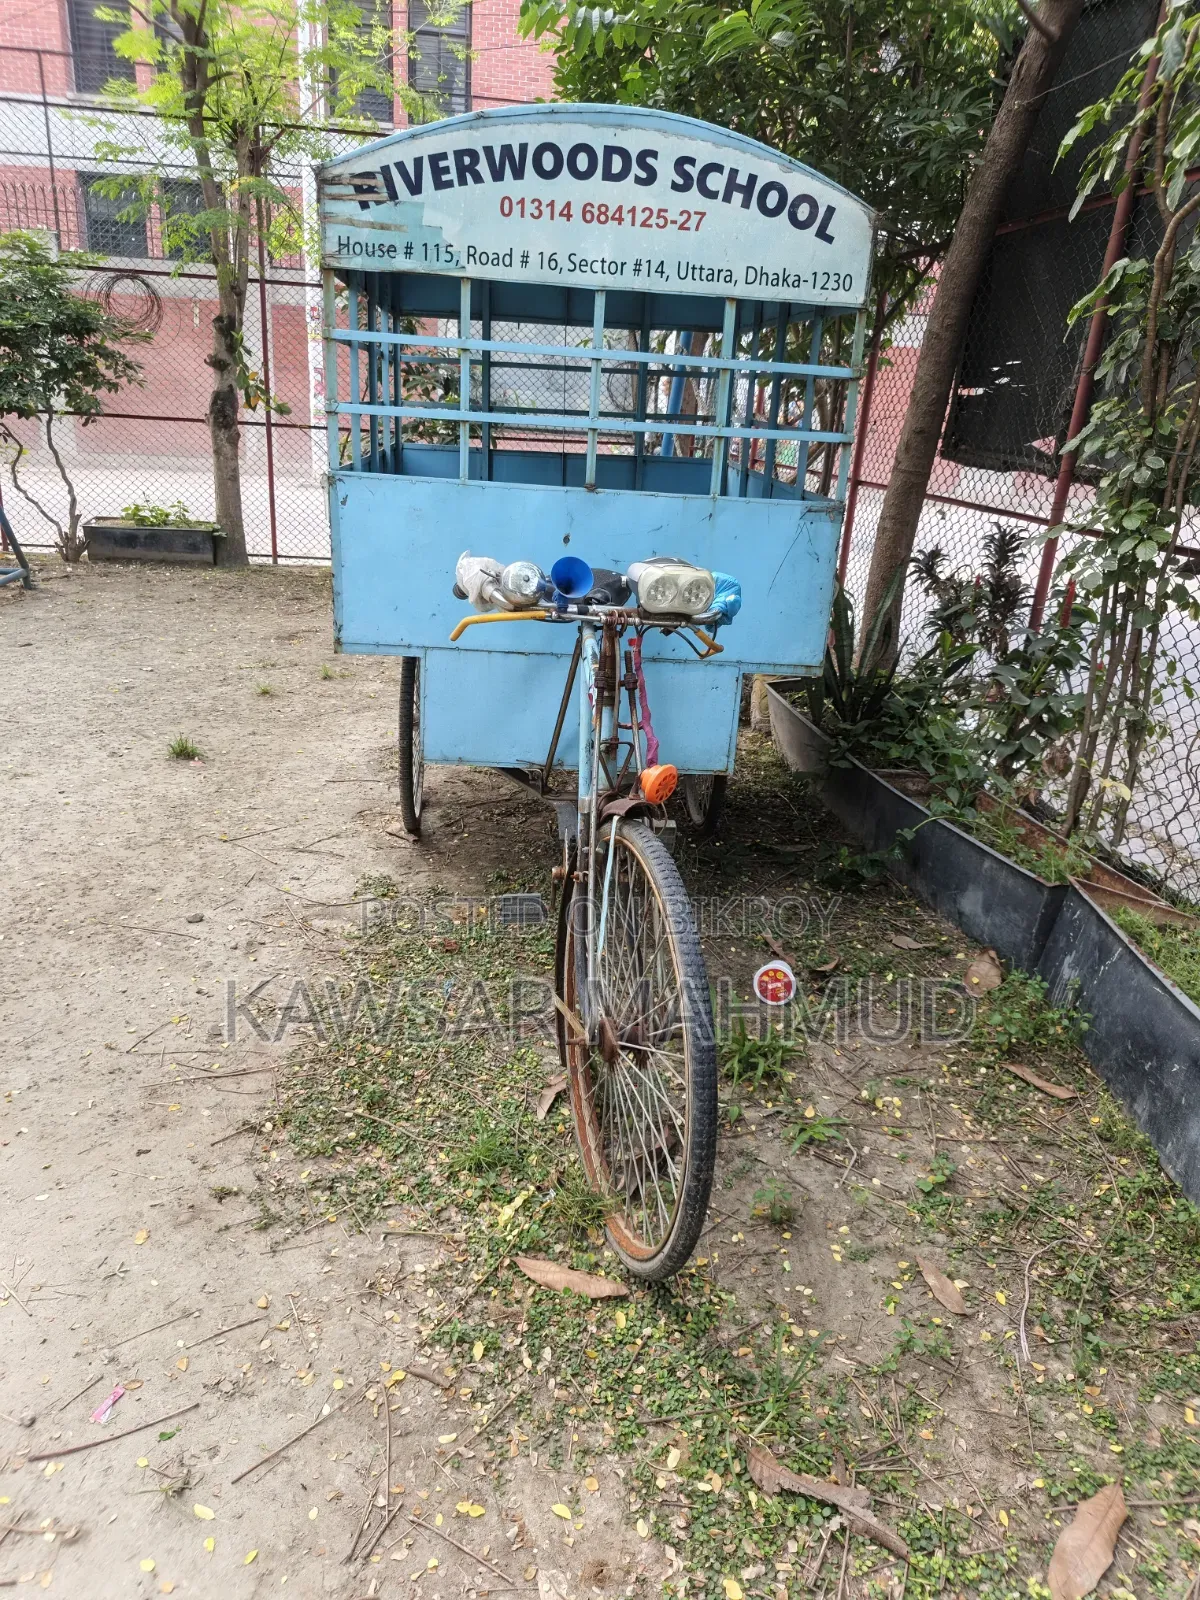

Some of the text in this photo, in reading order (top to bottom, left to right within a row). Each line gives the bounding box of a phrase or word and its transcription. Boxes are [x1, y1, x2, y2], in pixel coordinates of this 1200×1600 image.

[349, 141, 837, 245] RIVERWOODS SCHOOL
[499, 195, 707, 232] 01314 684125-27
[337, 235, 853, 292] House # 115, Road # 16, Sector #14, Uttara, Dhaka-1230
